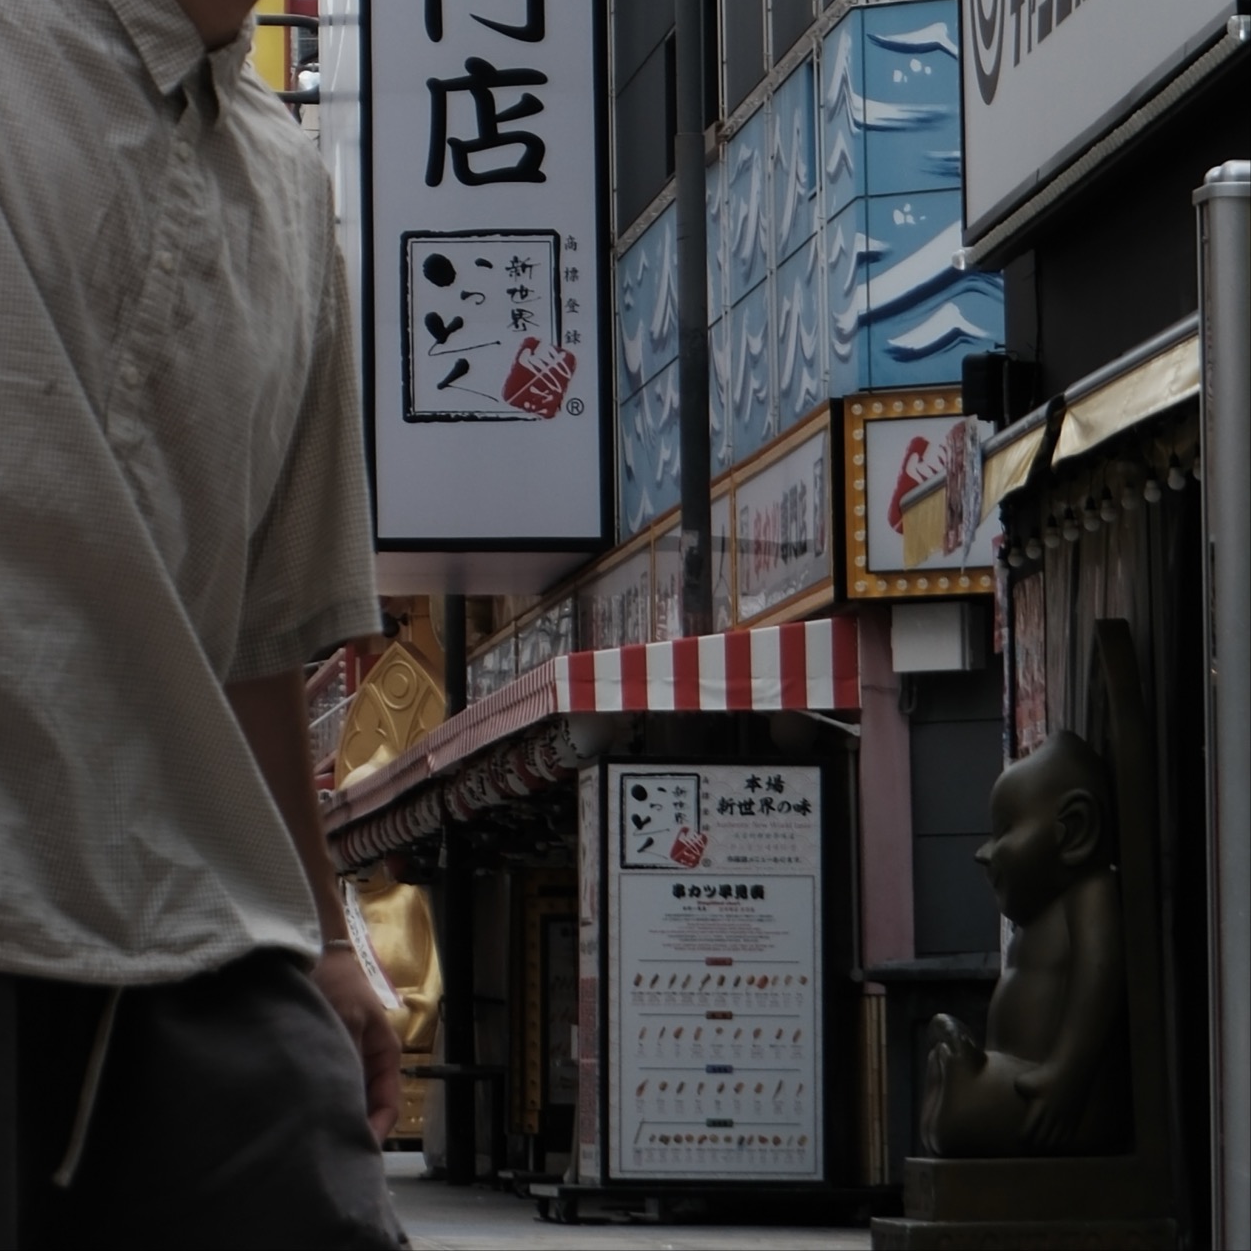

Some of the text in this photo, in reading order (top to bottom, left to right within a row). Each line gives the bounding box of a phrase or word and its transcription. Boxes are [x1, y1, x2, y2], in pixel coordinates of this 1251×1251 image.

[564, 235, 581, 345] 商標登録
[717, 797, 812, 816] 新世界の味
